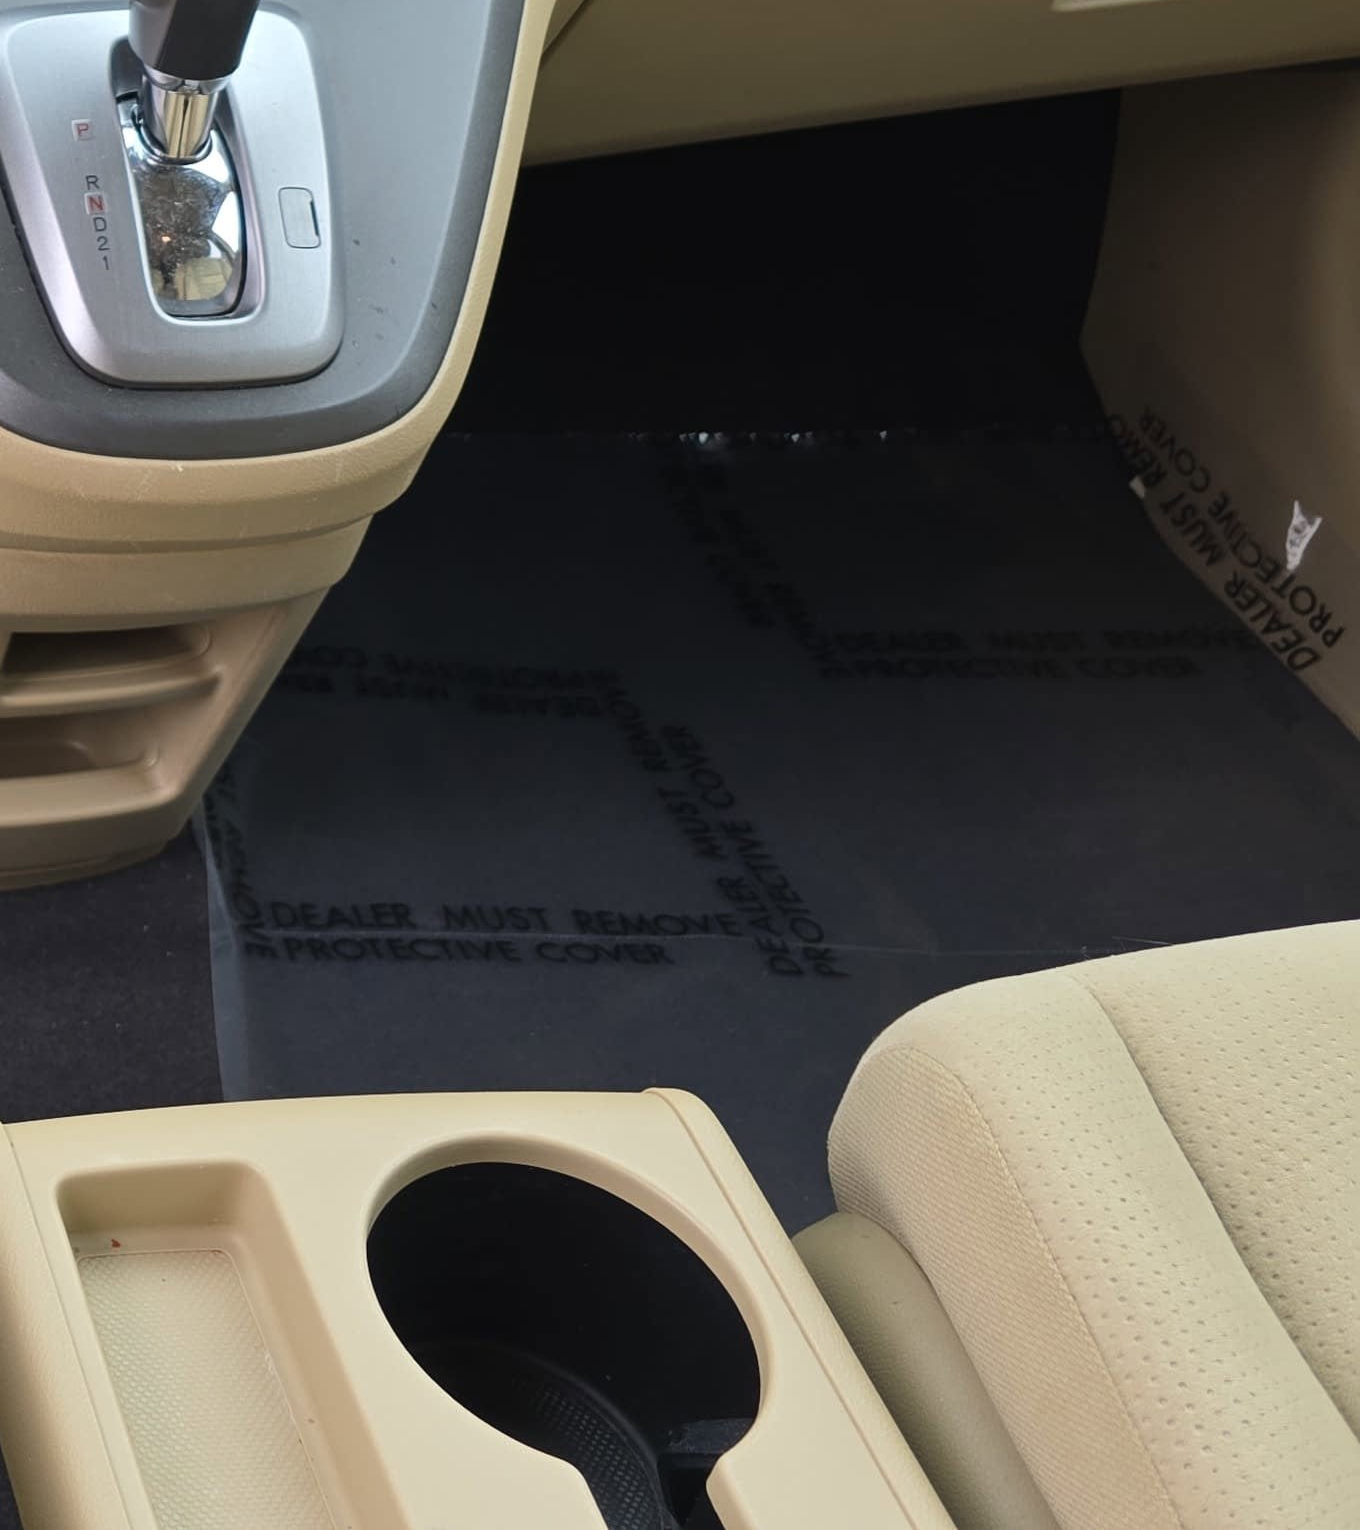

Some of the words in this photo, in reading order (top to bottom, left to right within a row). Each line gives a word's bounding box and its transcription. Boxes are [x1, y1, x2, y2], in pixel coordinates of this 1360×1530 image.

[77, 123, 89, 138] P
[86, 176, 100, 190] R
[89, 196, 103, 211] N
[93, 217, 107, 232] D
[97, 236, 110, 251] 2
[102, 256, 110, 270] 1
[1140, 405, 1211, 493] COVER
[1160, 492, 1225, 566] MUST
[1225, 570, 1321, 670] DEALER
[270, 902, 417, 932] DEALER
[440, 905, 551, 932] MUST
[572, 909, 745, 937] REMOVE
[279, 936, 521, 963] PROTECTIVE
[535, 939, 675, 965] COVER
